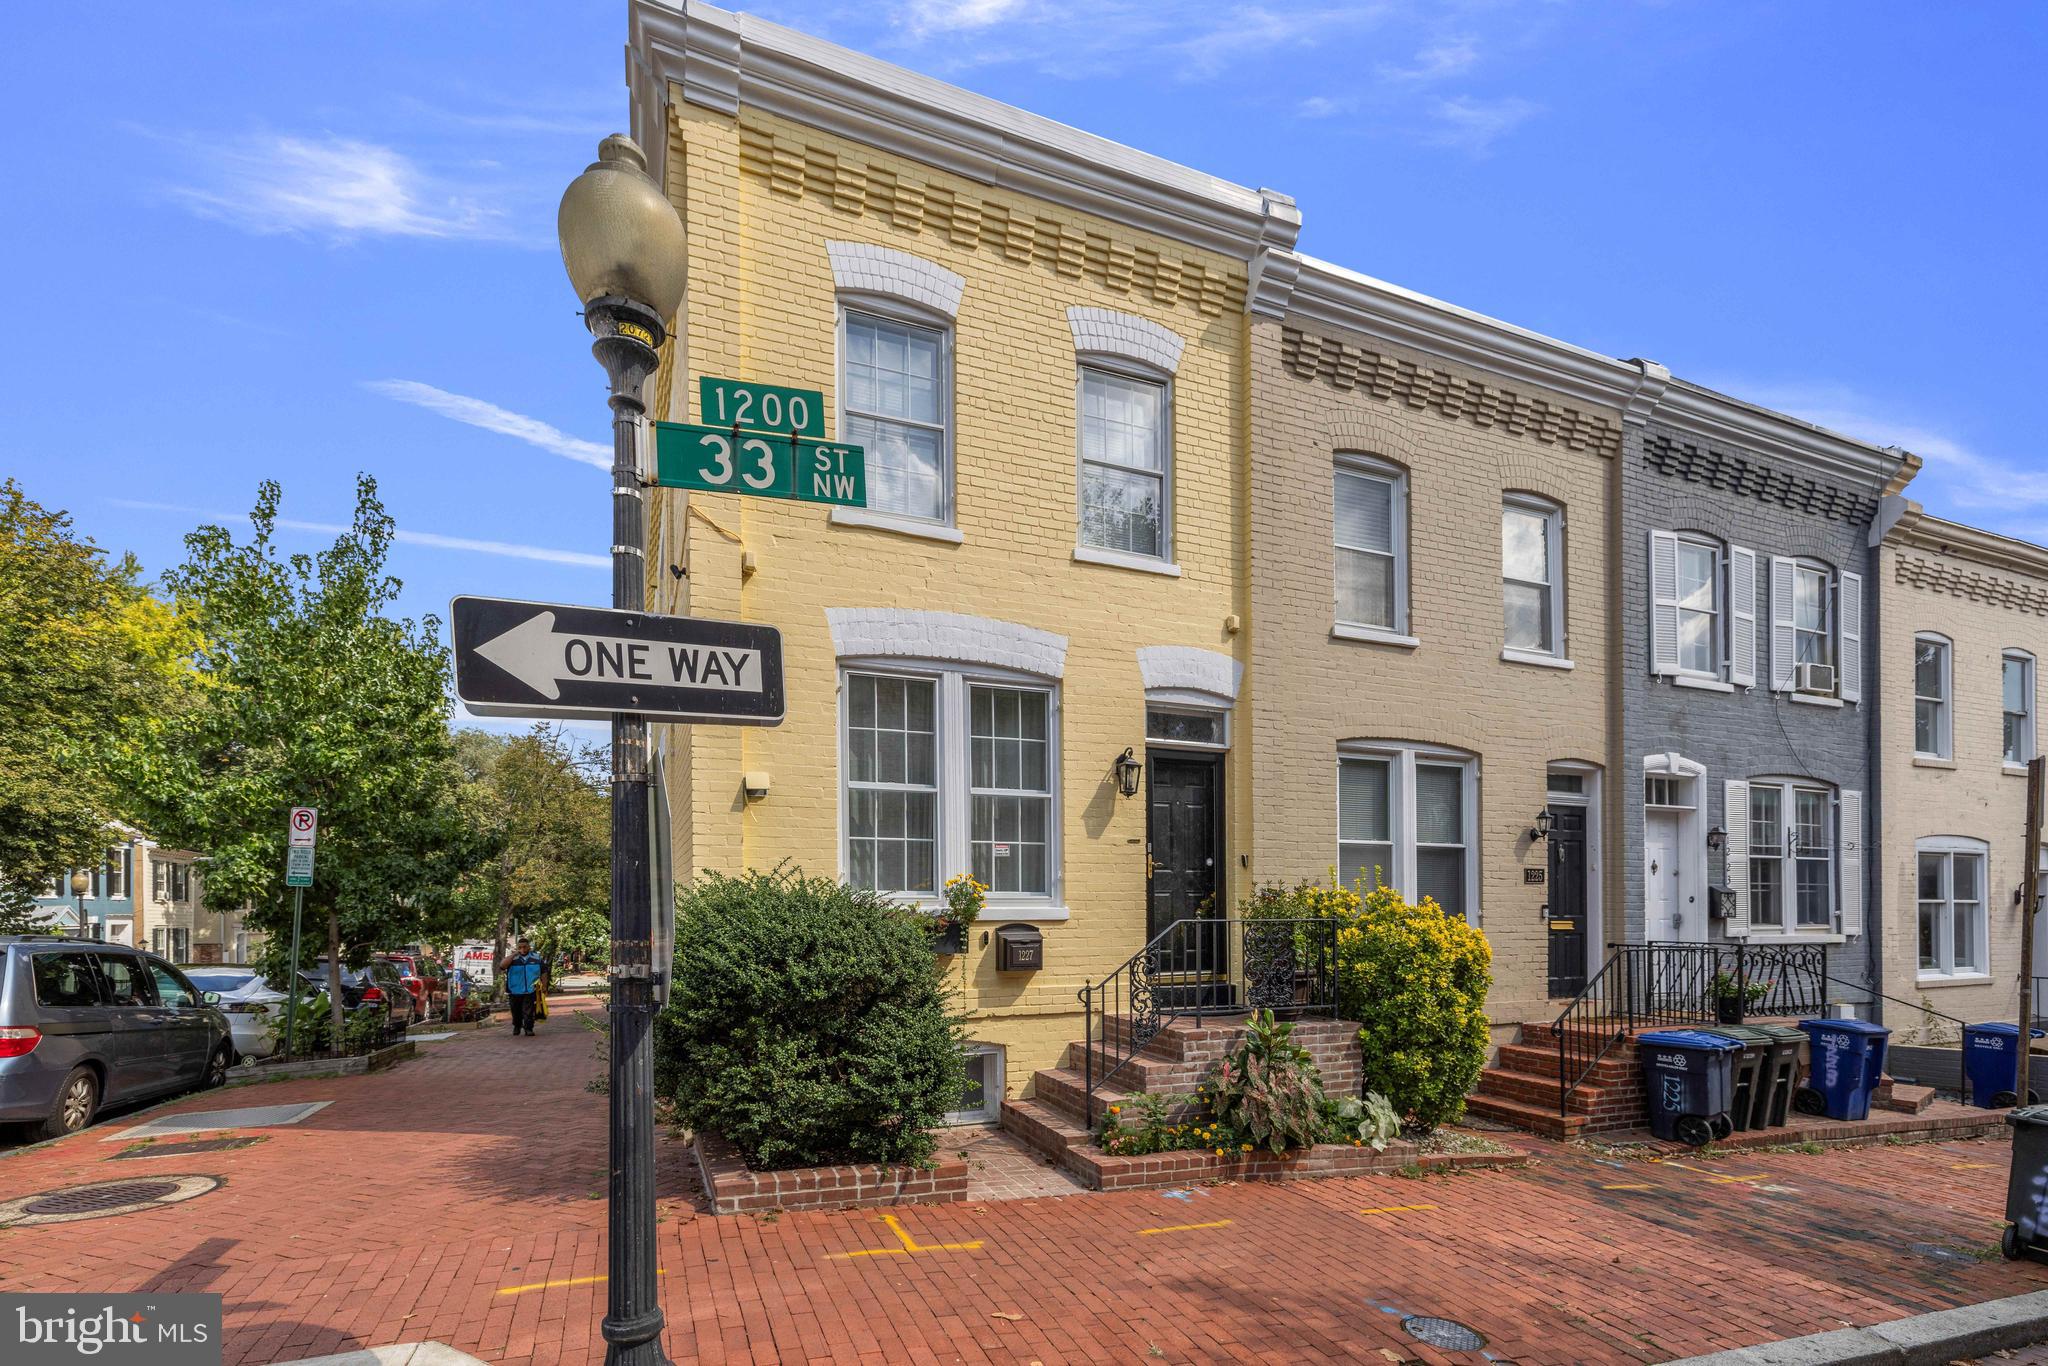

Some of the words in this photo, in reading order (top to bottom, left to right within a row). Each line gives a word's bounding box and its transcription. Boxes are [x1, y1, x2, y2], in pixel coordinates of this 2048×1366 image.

[716, 386, 808, 430] 1200
[699, 434, 776, 490] 33
[814, 445, 849, 474] ST
[813, 473, 855, 500] NW
[565, 639, 653, 681] ONE
[668, 647, 750, 686] WAY
[1527, 869, 1543, 882] 1225
[1018, 949, 1034, 961] 1227
[1663, 1073, 1681, 1112] 1225
